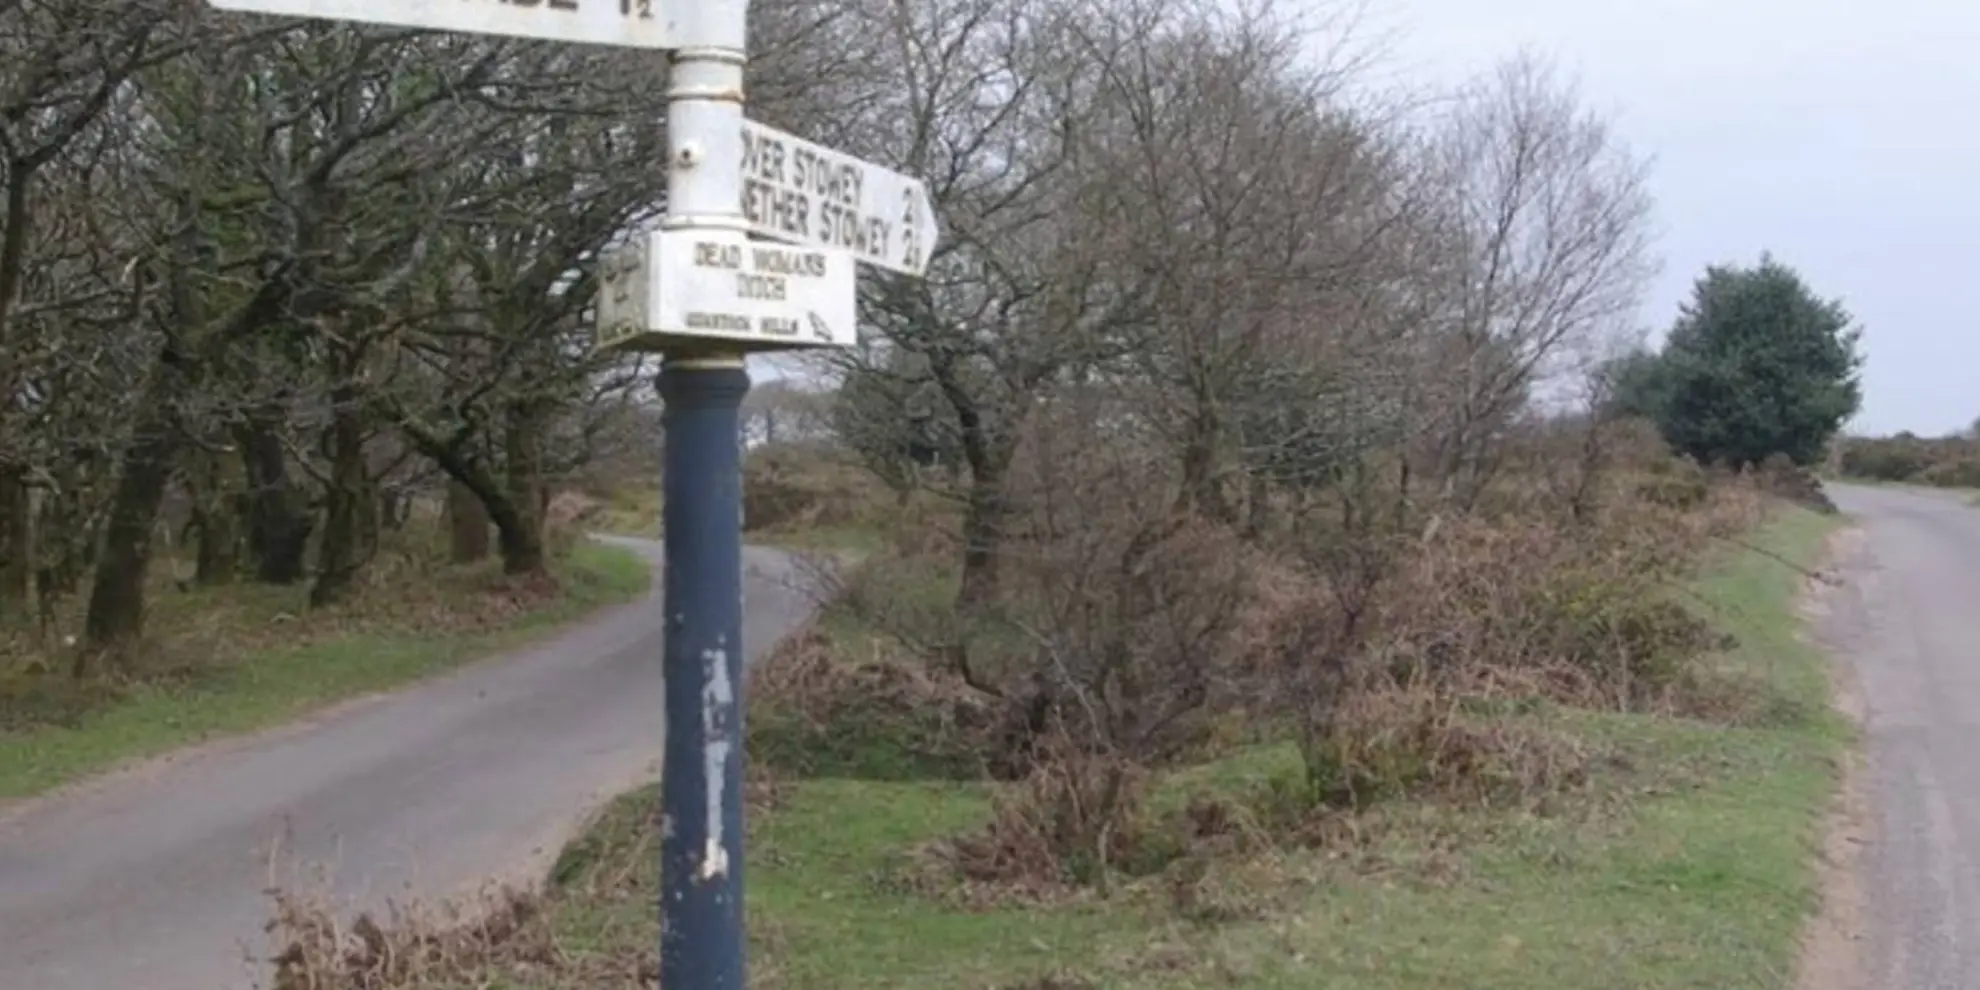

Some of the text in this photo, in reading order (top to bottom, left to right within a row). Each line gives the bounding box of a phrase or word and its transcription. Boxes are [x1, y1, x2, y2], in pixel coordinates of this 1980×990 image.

[793, 147, 864, 209] STOWEY
[820, 200, 893, 259] STOWEY
[694, 241, 827, 277] DEAD WOMANS
[737, 273, 787, 300] DITCH
